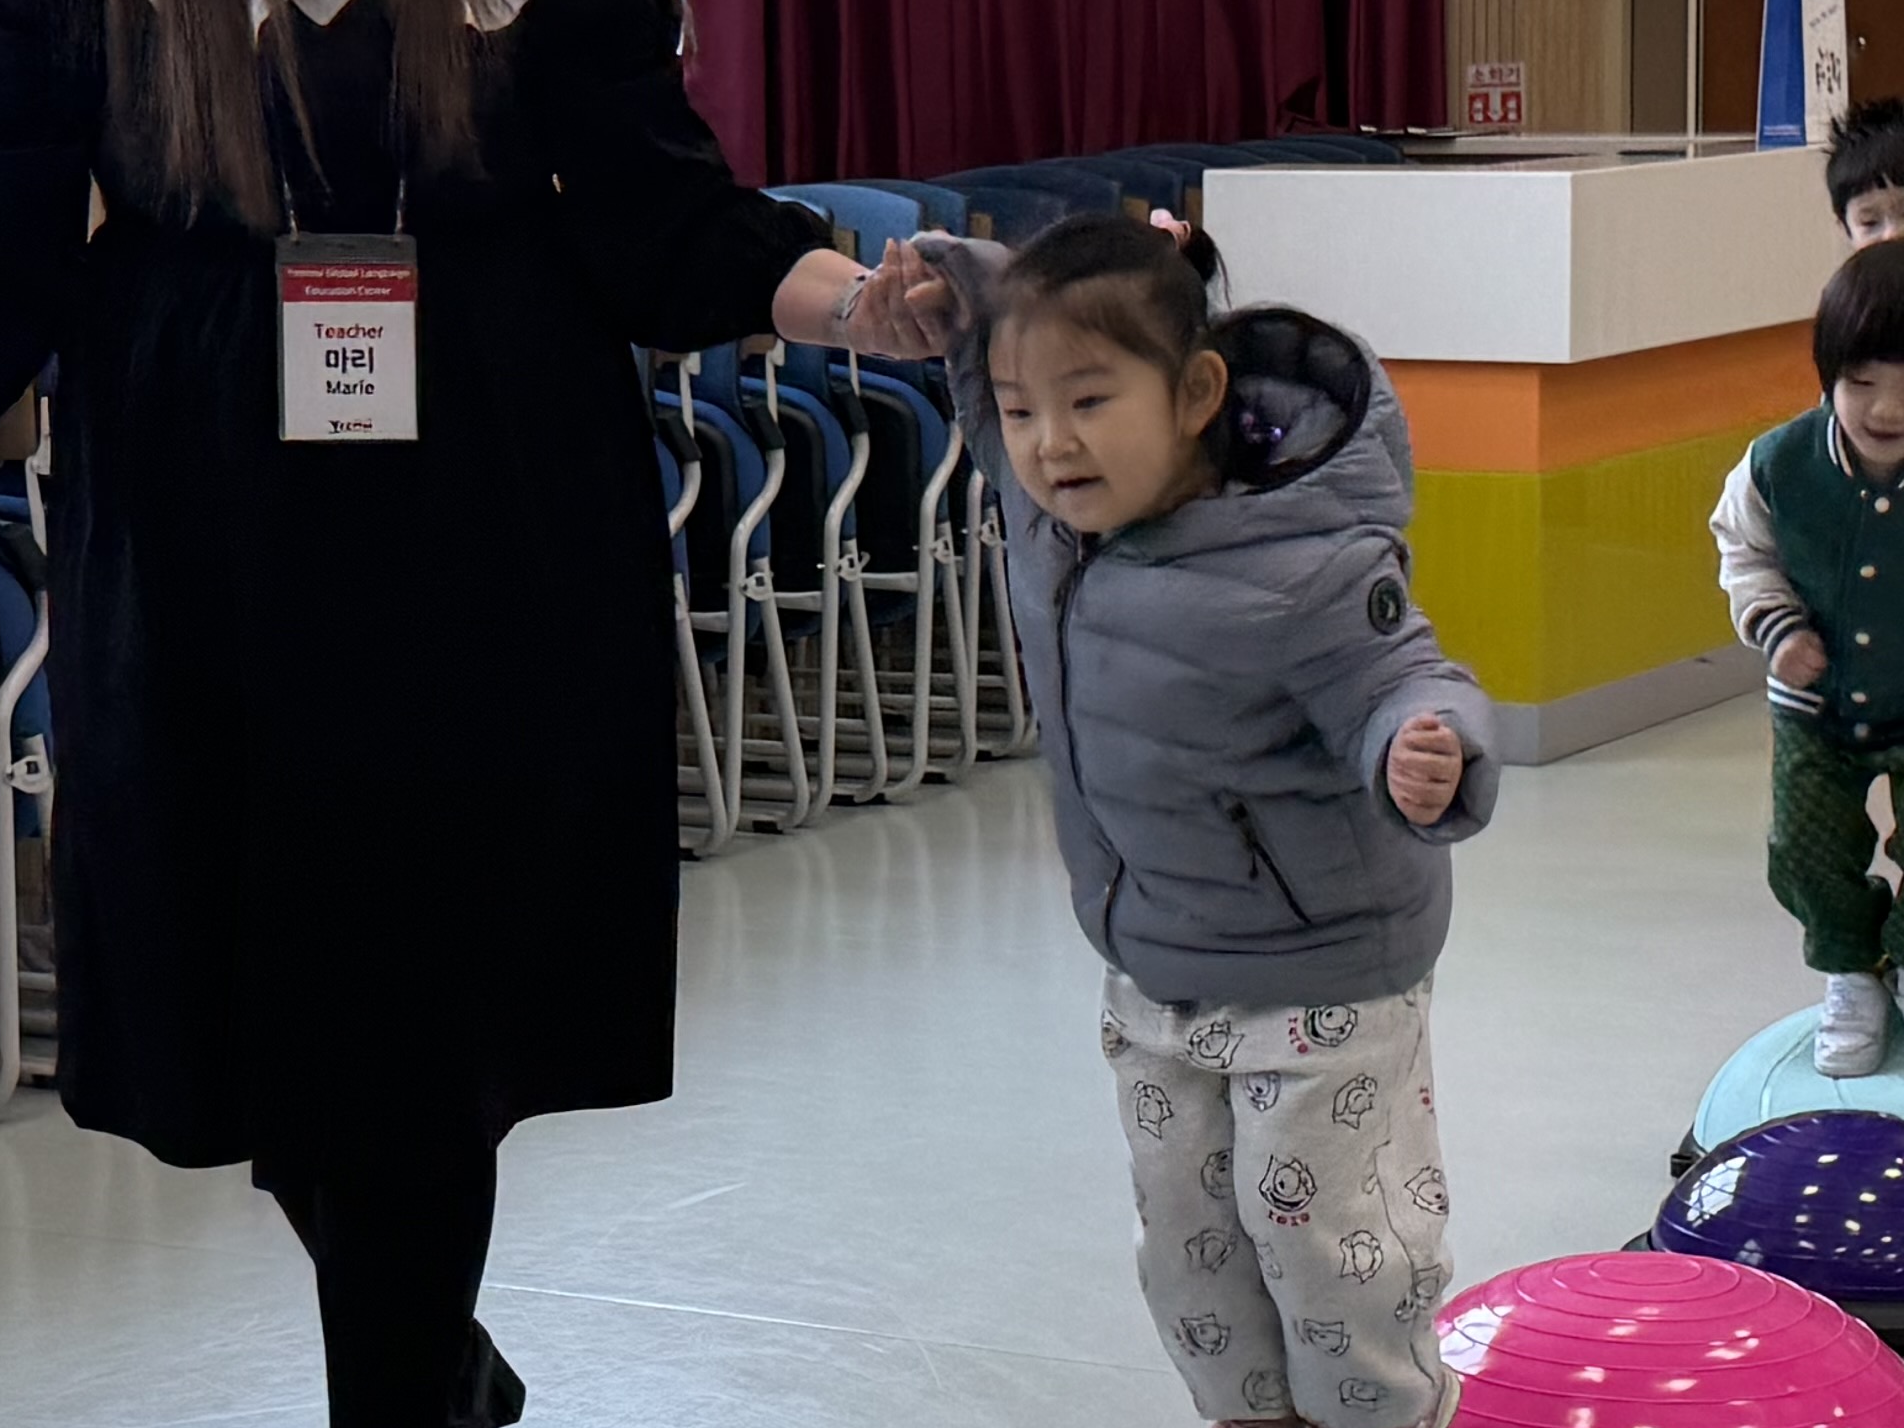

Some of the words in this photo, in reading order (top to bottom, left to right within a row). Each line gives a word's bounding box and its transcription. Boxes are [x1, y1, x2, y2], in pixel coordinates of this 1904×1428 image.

[314, 323, 383, 339] Teacher
[325, 346, 374, 374] 마리
[326, 379, 375, 395] Marie
